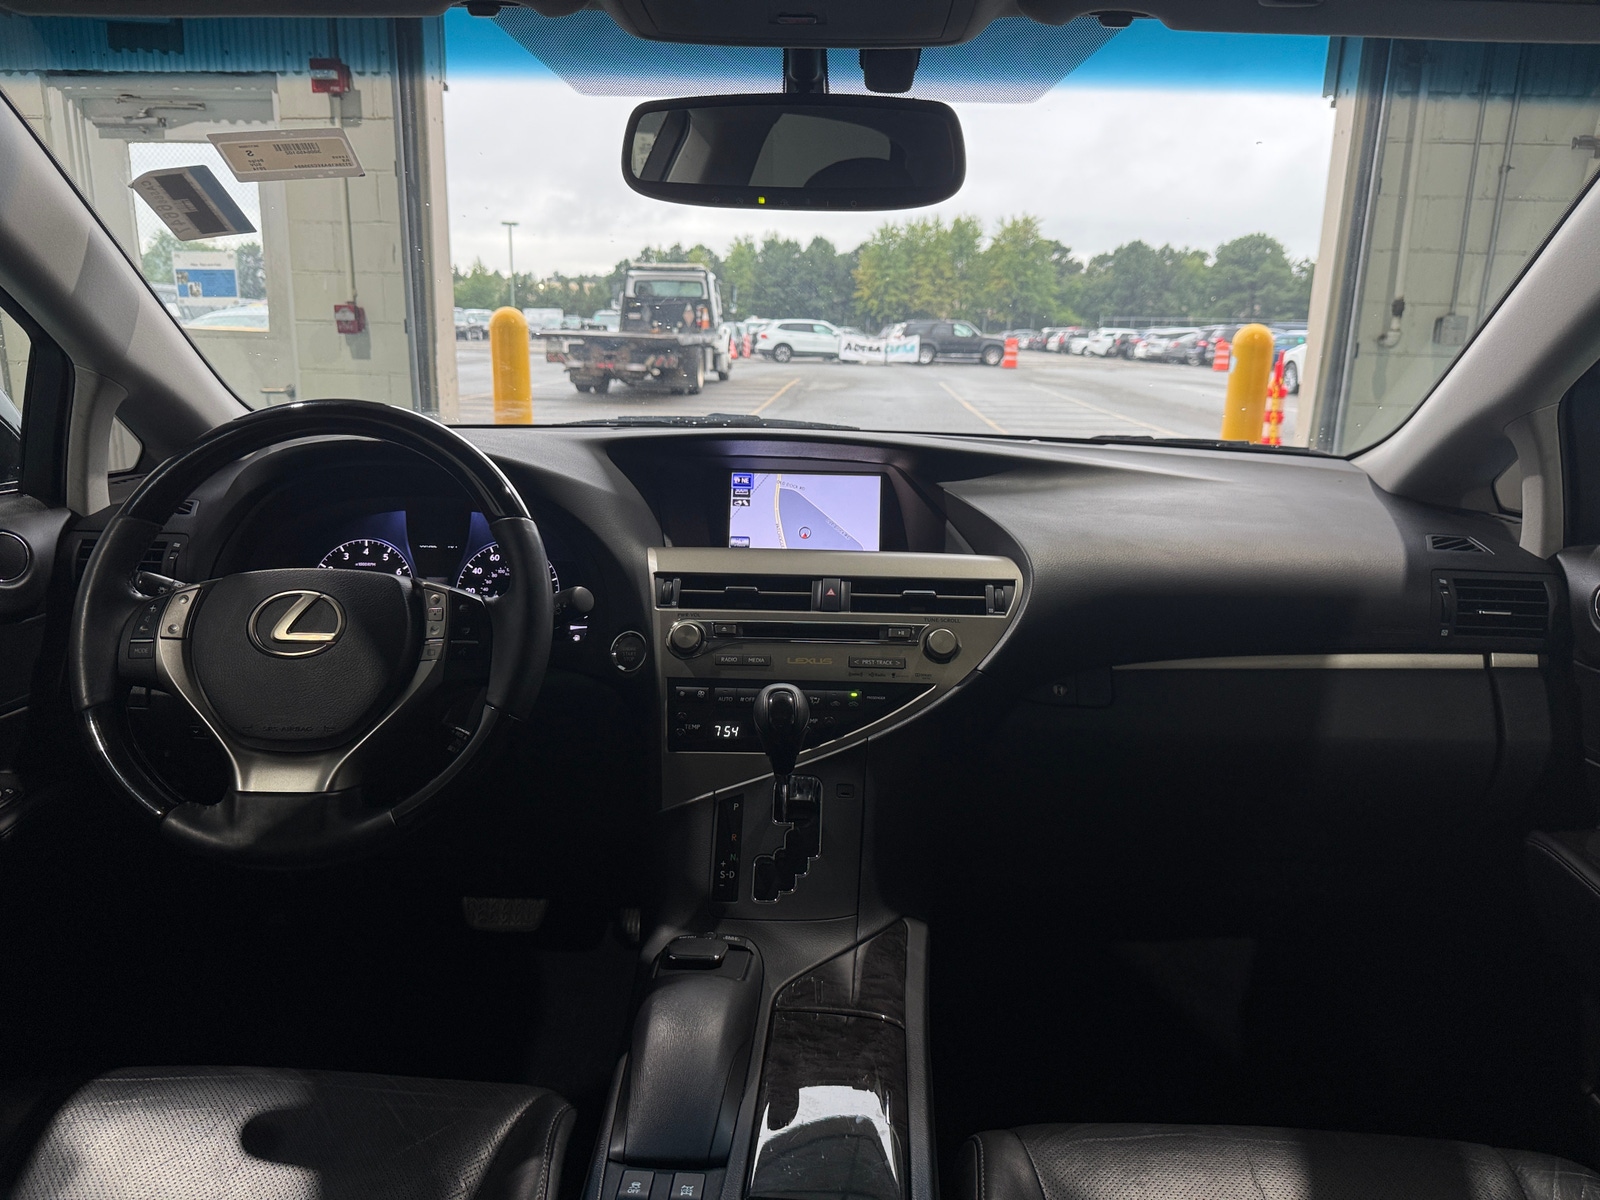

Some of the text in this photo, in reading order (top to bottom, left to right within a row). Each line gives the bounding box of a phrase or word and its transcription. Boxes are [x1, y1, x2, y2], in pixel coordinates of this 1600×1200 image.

[363, 547, 369, 556] 4
[343, 552, 349, 561] 3
[382, 553, 389, 562] 5
[489, 554, 500, 562] 60
[396, 567, 402, 576] 6
[472, 567, 483, 575] 40
[787, 656, 833, 665] LEXUS
[685, 723, 701, 731] TEMP
[733, 802, 740, 811] P
[731, 833, 738, 842] R
[730, 853, 736, 862] N
